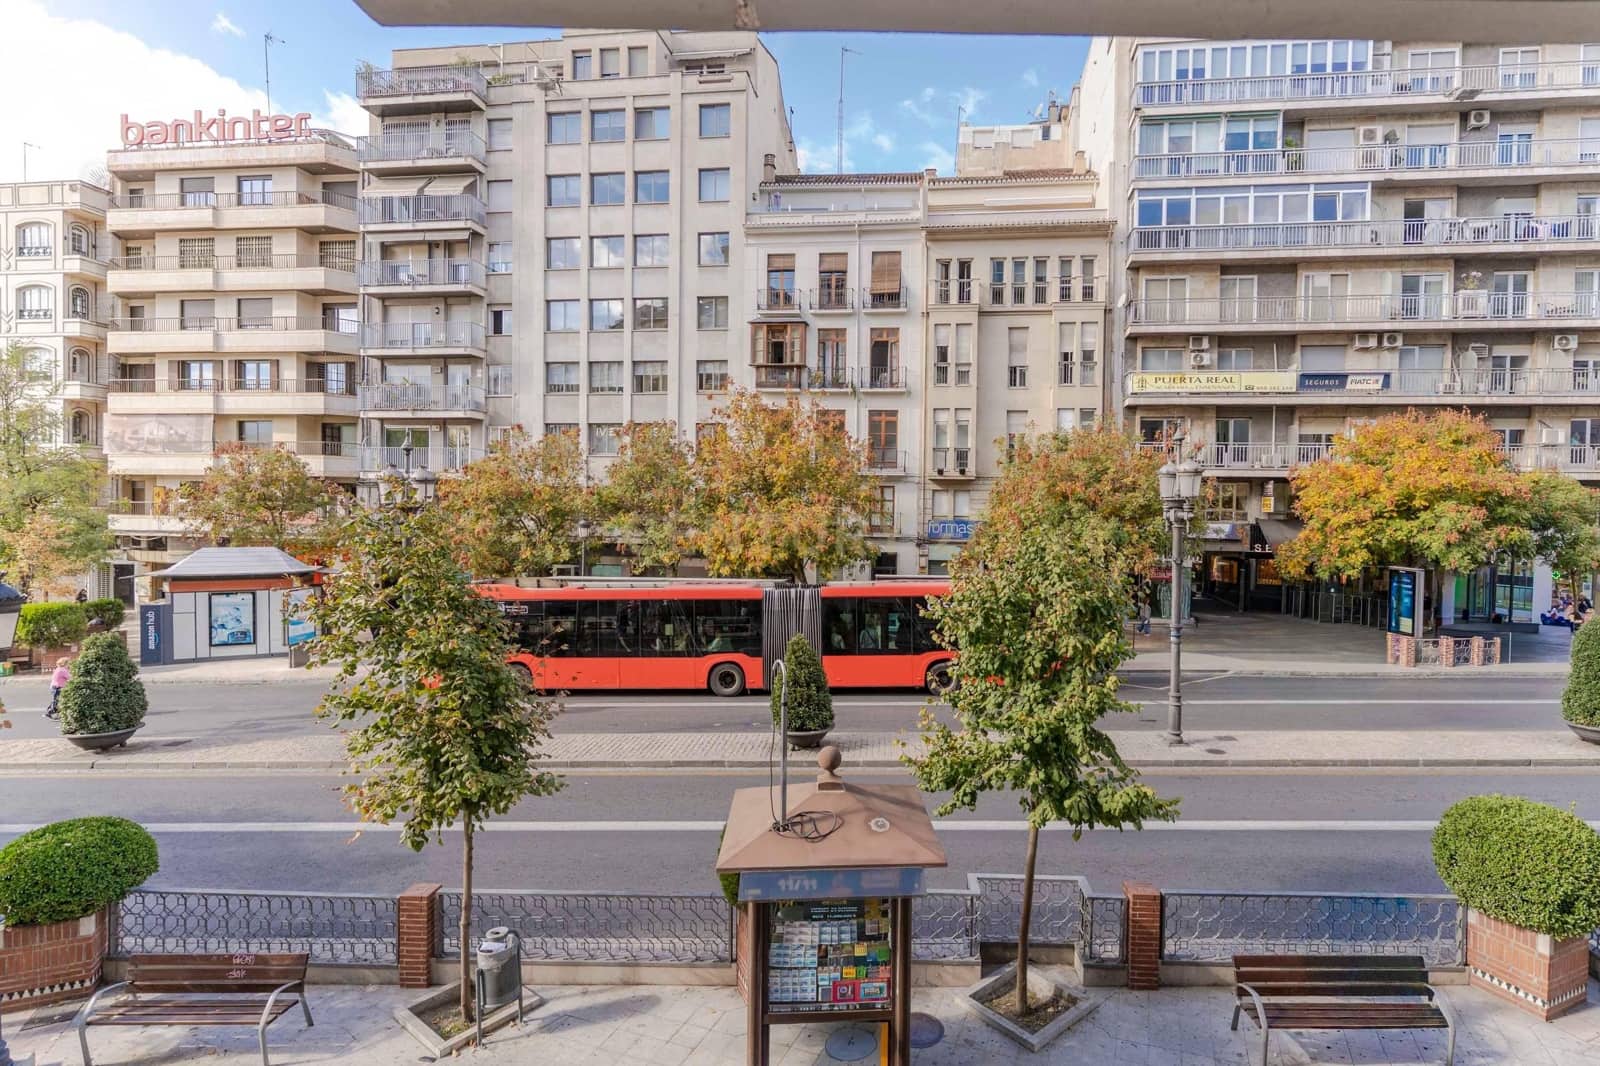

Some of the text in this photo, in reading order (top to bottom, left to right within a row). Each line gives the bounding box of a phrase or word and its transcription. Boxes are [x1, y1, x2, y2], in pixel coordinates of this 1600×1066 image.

[1154, 376, 1236, 384] PUERTA REAL
[146, 611, 155, 625] hub
